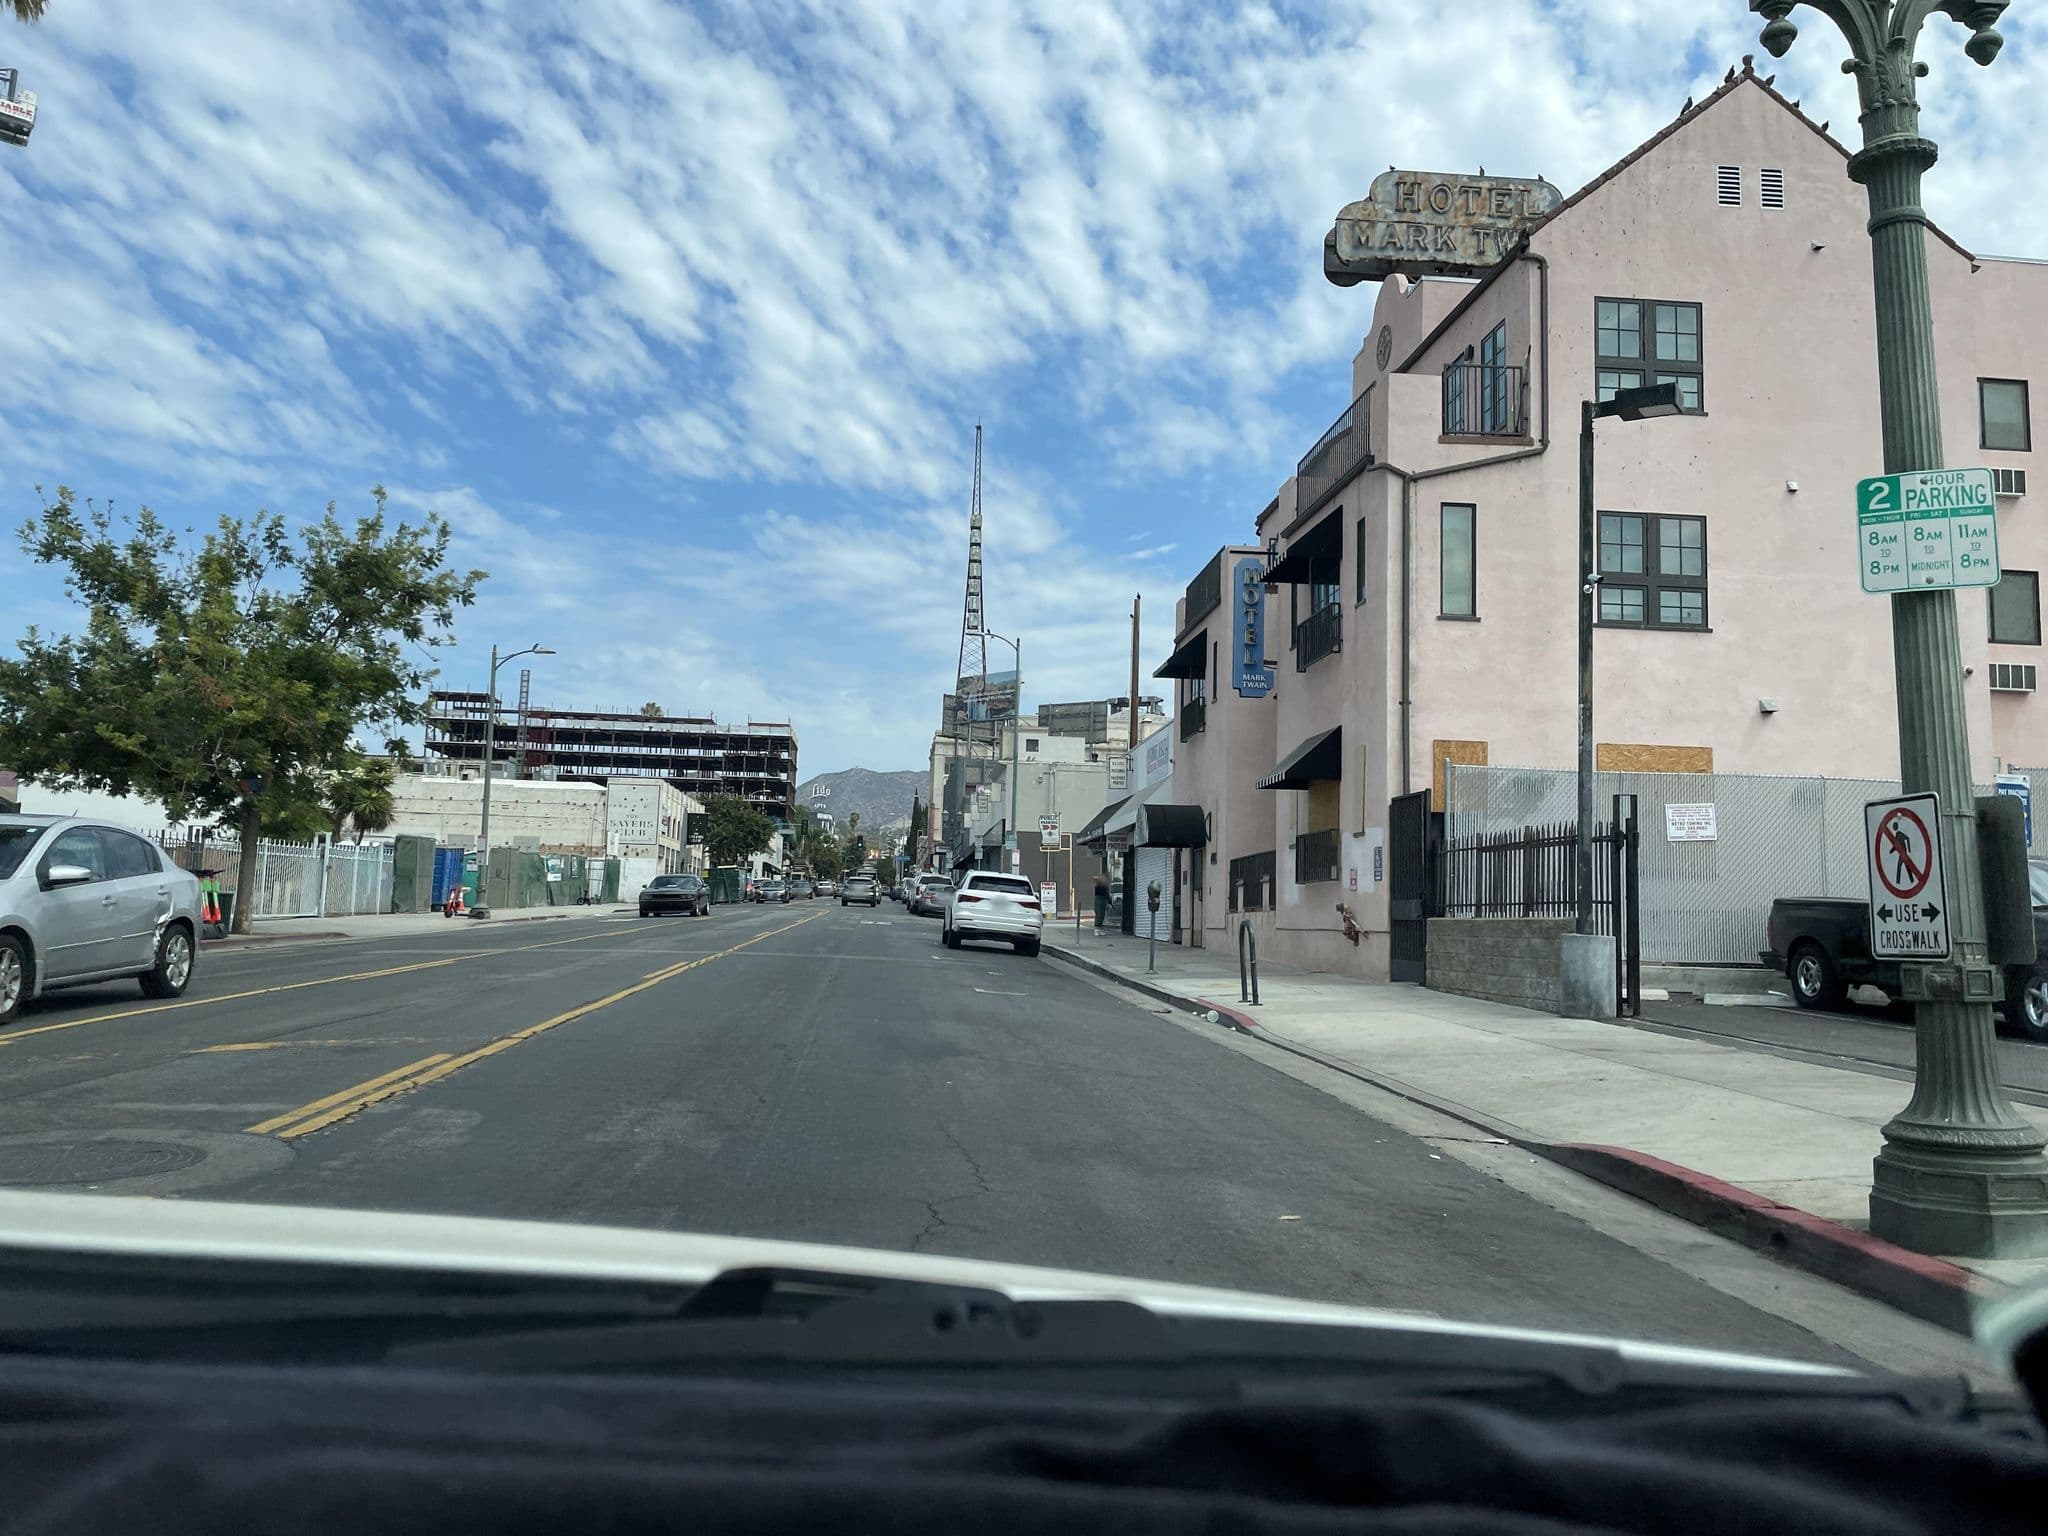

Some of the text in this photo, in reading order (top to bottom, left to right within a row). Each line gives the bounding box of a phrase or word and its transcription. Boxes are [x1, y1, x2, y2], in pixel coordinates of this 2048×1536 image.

[1395, 181, 1546, 219] HOTEL
[1351, 221, 1456, 252] MARK
[1924, 473, 1965, 486] HOUR
[1868, 481, 1891, 511] 2
[1905, 483, 1987, 510] PARKING
[1960, 507, 1984, 515] SUNDAY
[1911, 560, 1950, 572] MIDNIGHT
[1242, 567, 1260, 666] HOTEL
[1243, 681, 1267, 689] TWAIN
[810, 783, 831, 798] Lido
[610, 820, 653, 828] SAYERS
[1895, 903, 1919, 923] USE
[1880, 929, 1941, 950] CROSSWALK
